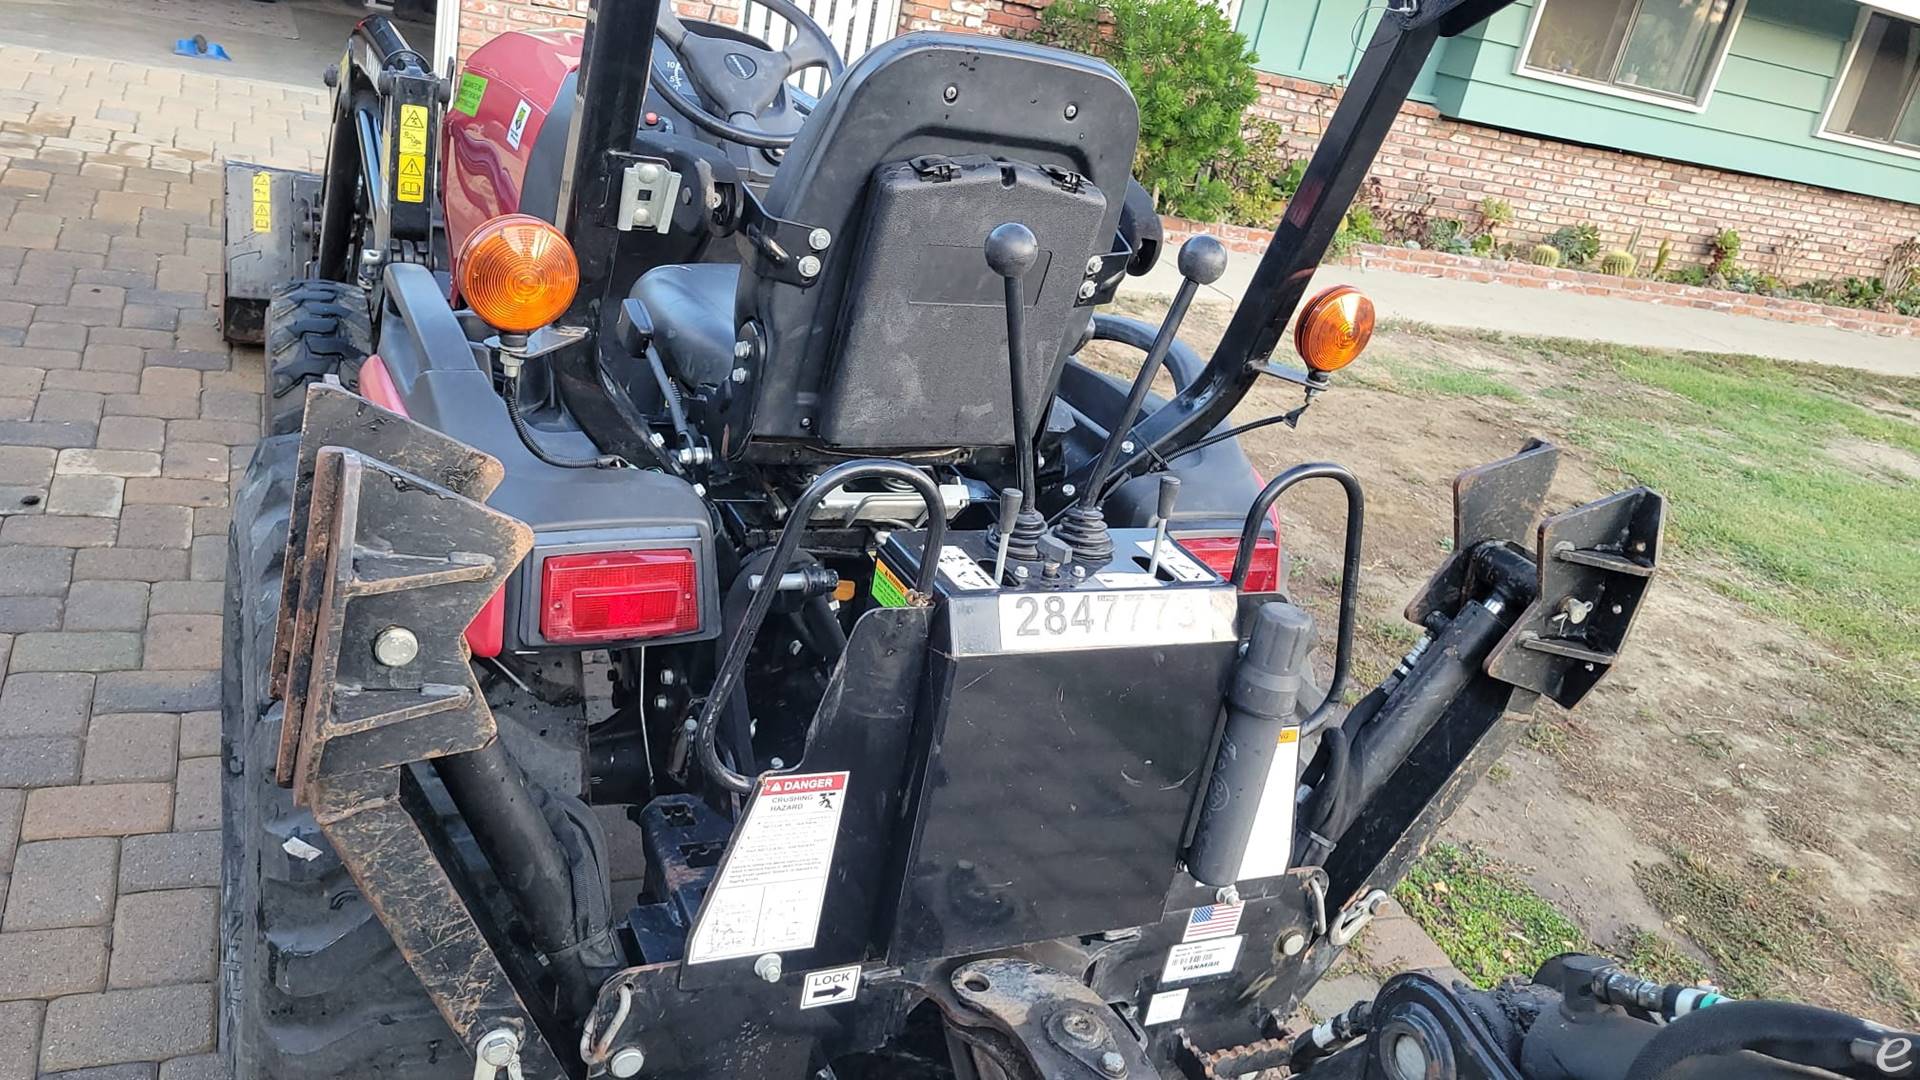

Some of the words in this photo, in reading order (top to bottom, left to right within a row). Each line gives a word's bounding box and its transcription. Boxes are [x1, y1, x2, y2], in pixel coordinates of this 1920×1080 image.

[784, 778, 833, 791] DANGER
[771, 795, 814, 804] CRUSHING
[770, 803, 804, 812] HAZARD
[1183, 961, 1220, 971] YANMAR
[814, 972, 850, 986] LOCK
